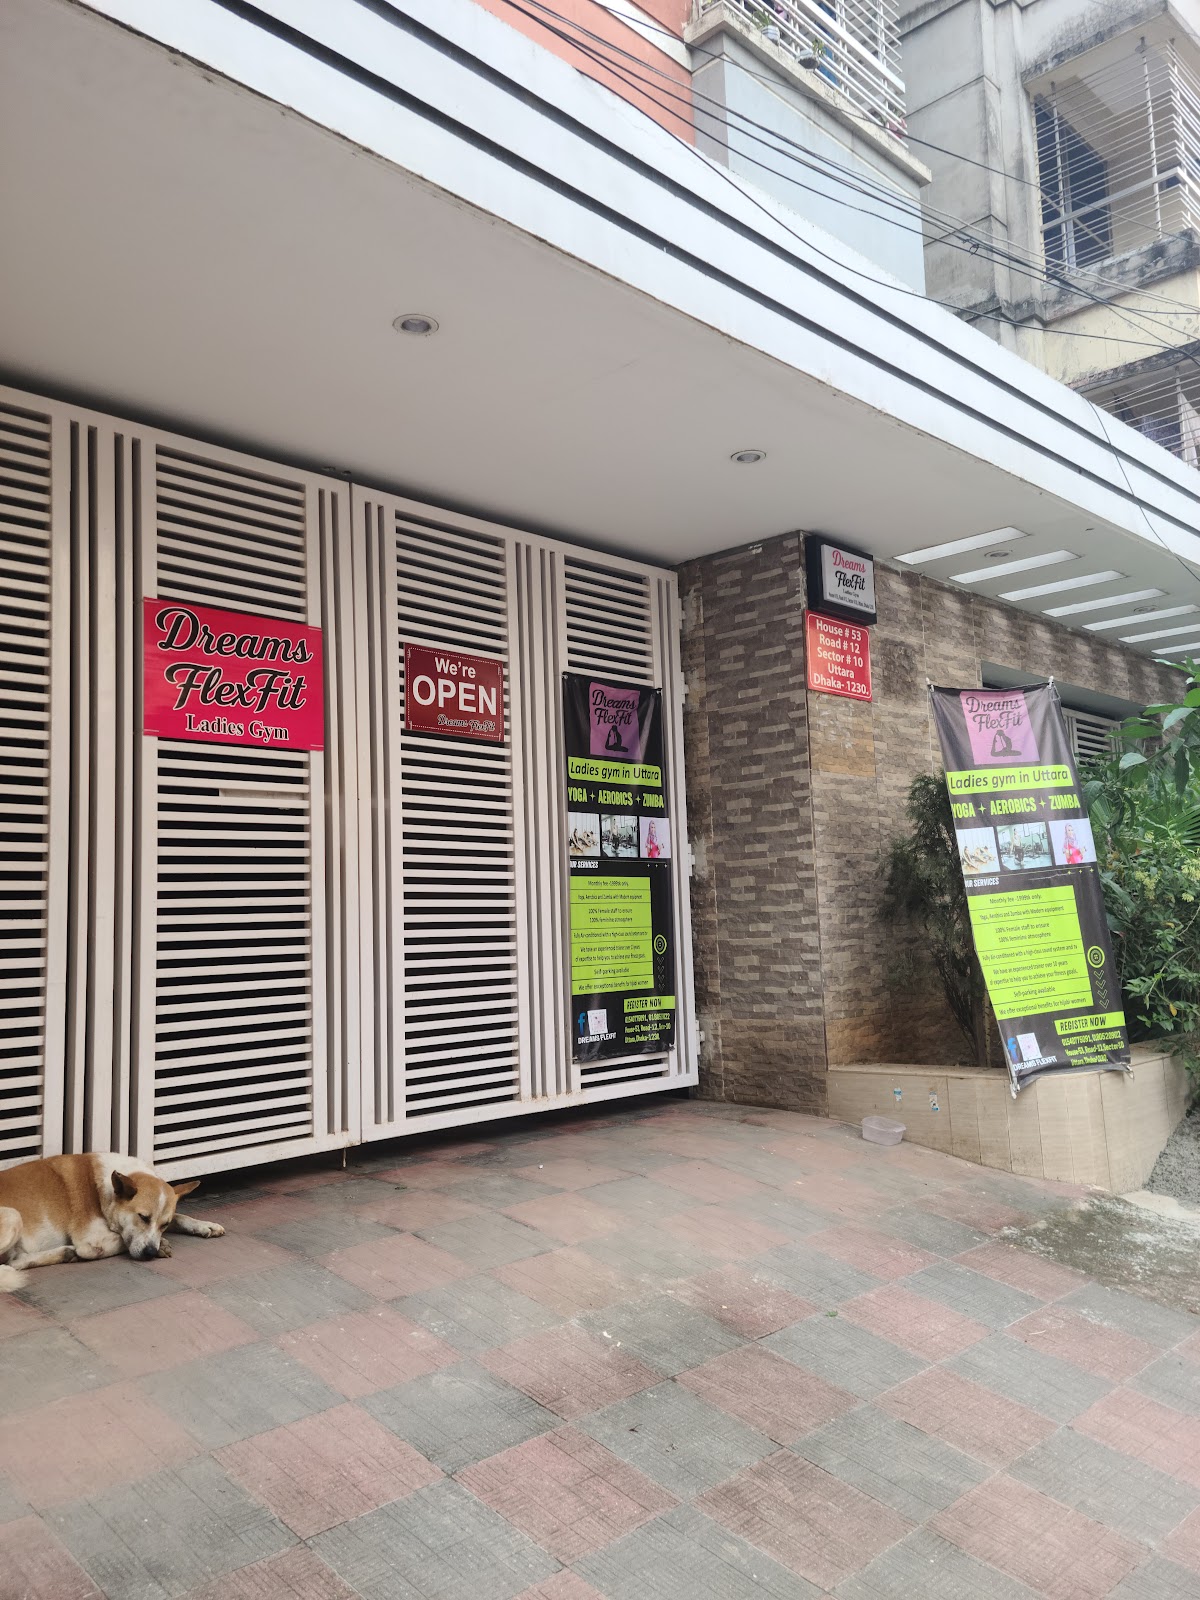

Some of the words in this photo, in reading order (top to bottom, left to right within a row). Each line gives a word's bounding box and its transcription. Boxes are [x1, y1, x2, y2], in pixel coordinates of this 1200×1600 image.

[832, 550, 866, 573] Dreams
[835, 570, 865, 590] FlexFit
[155, 607, 313, 664] Dreams
[816, 619, 843, 636] House
[845, 628, 850, 638] #
[852, 630, 861, 641] 53
[820, 634, 841, 649] Road
[843, 641, 848, 650] #
[850, 642, 860, 654] 12
[817, 647, 844, 662] Sector
[846, 655, 851, 664] #
[854, 656, 863, 667] 10
[435, 657, 476, 678] We're
[828, 663, 854, 678] Uttara
[164, 662, 306, 713] FlexFit
[413, 675, 496, 716] OPEN
[846, 681, 869, 695] 1230.
[592, 690, 636, 710] Dreams
[966, 697, 1022, 713] Dreams
[437, 714, 468, 727] Dreams
[594, 708, 632, 726] FlexFit
[973, 711, 1023, 732] FlexFit
[186, 714, 244, 736] Ladies
[249, 721, 289, 742] Gym
[571, 762, 599, 776] Ladies
[602, 768, 620, 779] gym
[622, 767, 630, 778] in
[634, 768, 659, 780] Uttara
[950, 775, 988, 789] Ladies
[992, 775, 1015, 788] gym
[1020, 771, 1029, 783] in
[1033, 770, 1068, 782] Uttara
[568, 787, 587, 802] YOGA
[598, 790, 633, 806] AEROBICS
[643, 793, 664, 808] ZUMBA
[951, 802, 976, 818] YOGA
[990, 797, 1036, 816] AEROBICS
[1048, 794, 1080, 810] ZUMBA
[974, 878, 1000, 887] SERVICES
[1060, 1019, 1088, 1031] REGISTER
[1090, 1016, 1106, 1026] NOW
[578, 1035, 600, 1044] DREAMS
[600, 1032, 616, 1041] FLEXFIT
[1013, 1061, 1036, 1070] DREAMS
[1036, 1056, 1057, 1066] FLEXFIT
